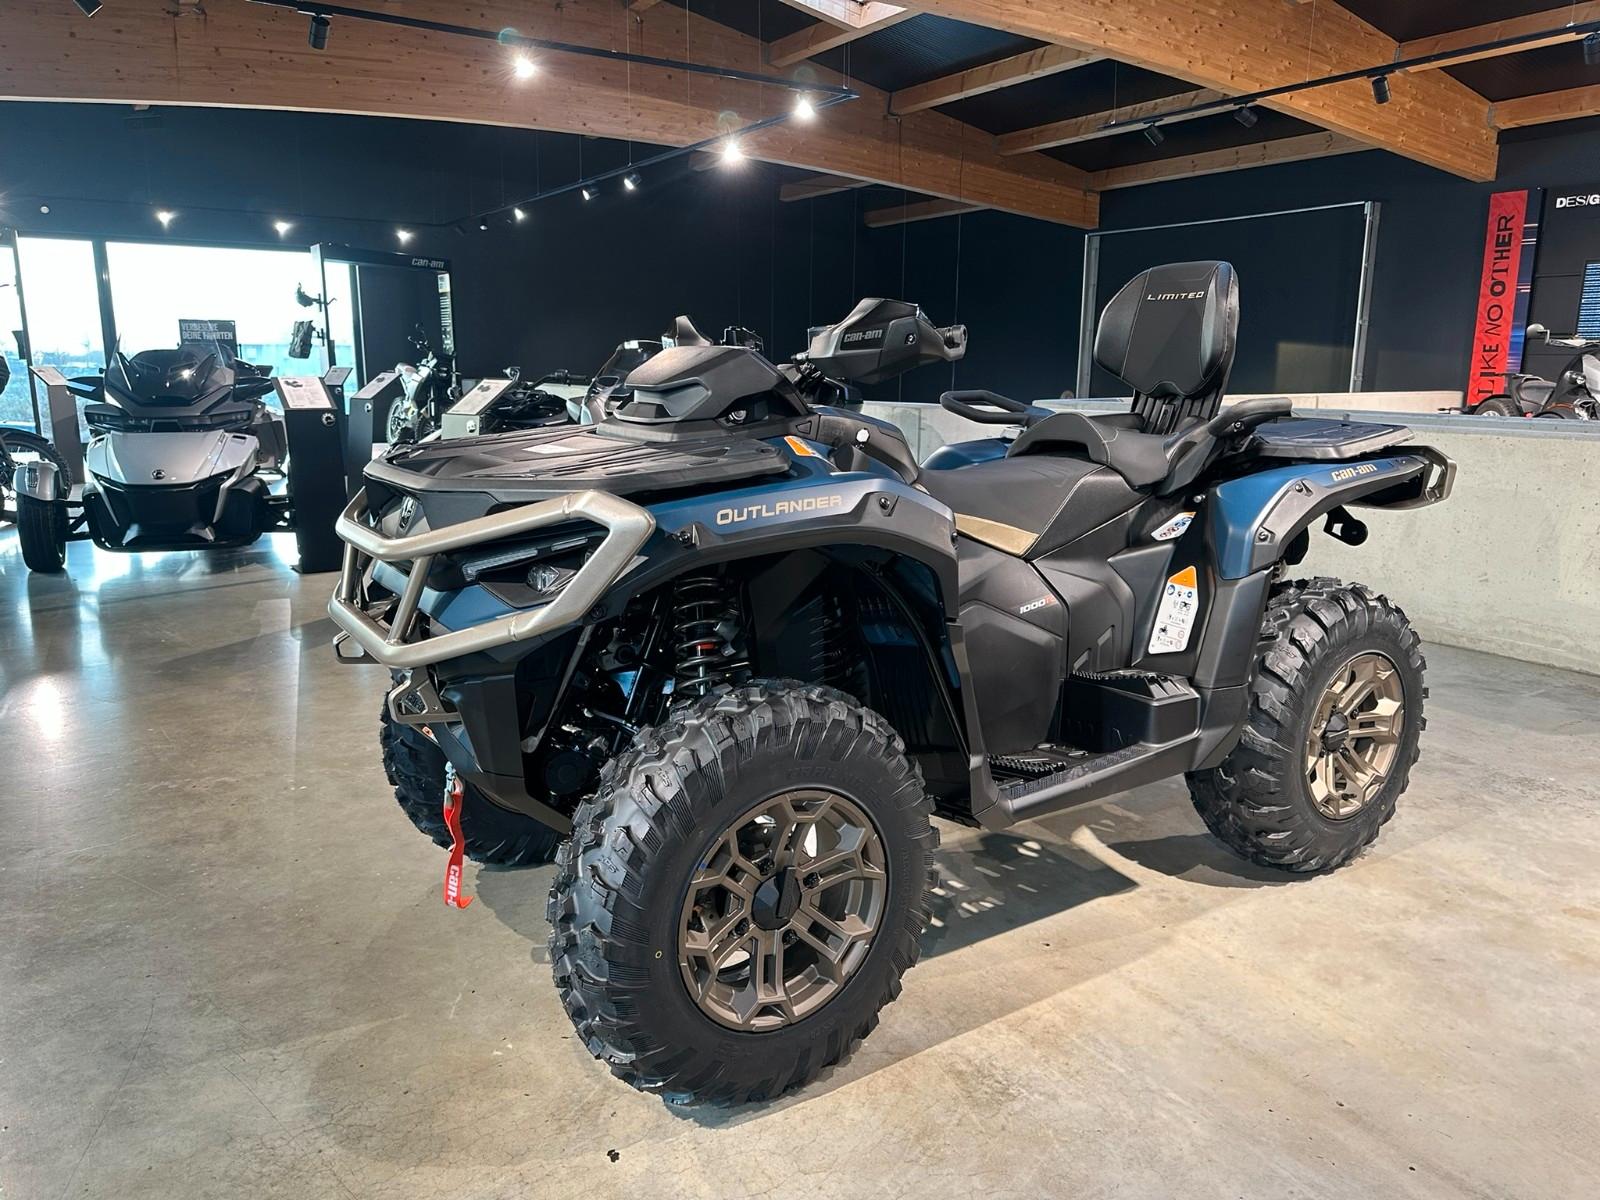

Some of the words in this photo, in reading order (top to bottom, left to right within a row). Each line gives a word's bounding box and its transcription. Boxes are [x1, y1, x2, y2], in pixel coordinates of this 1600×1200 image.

[411, 257, 445, 269] can-am
[1489, 213, 1516, 297] OTHER
[1147, 291, 1205, 301] LIMITED
[1484, 304, 1504, 337] NO
[843, 329, 883, 343] can-am
[1477, 343, 1500, 396] LIKE
[1331, 463, 1378, 482] can-am
[716, 495, 842, 525] OUTLANDER
